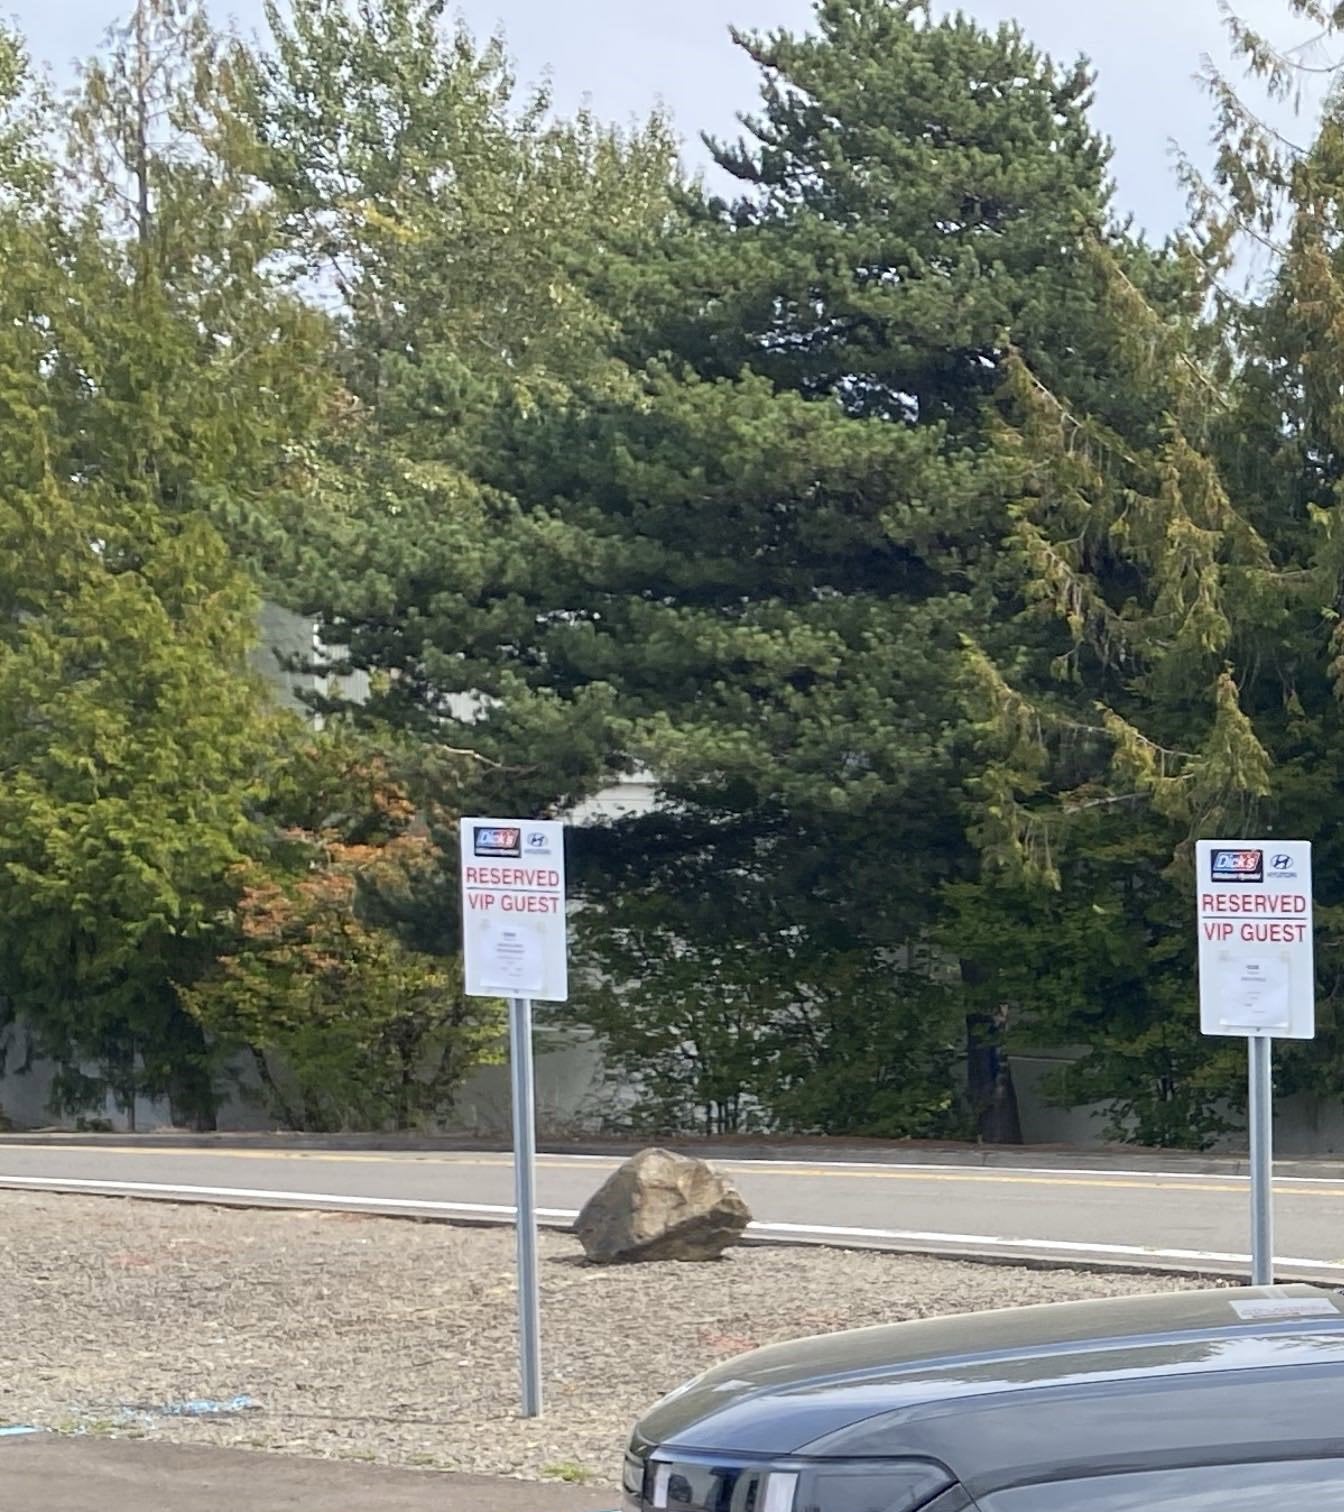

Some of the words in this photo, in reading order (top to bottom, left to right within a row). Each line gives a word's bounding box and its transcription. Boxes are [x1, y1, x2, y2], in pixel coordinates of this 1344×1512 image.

[466, 867, 560, 887] RESERVED
[468, 894, 495, 911] VIP
[501, 895, 560, 914] GUEST
[1202, 893, 1306, 913] RESERVED
[1204, 923, 1234, 941] VIP
[1241, 923, 1307, 943] GUEST
